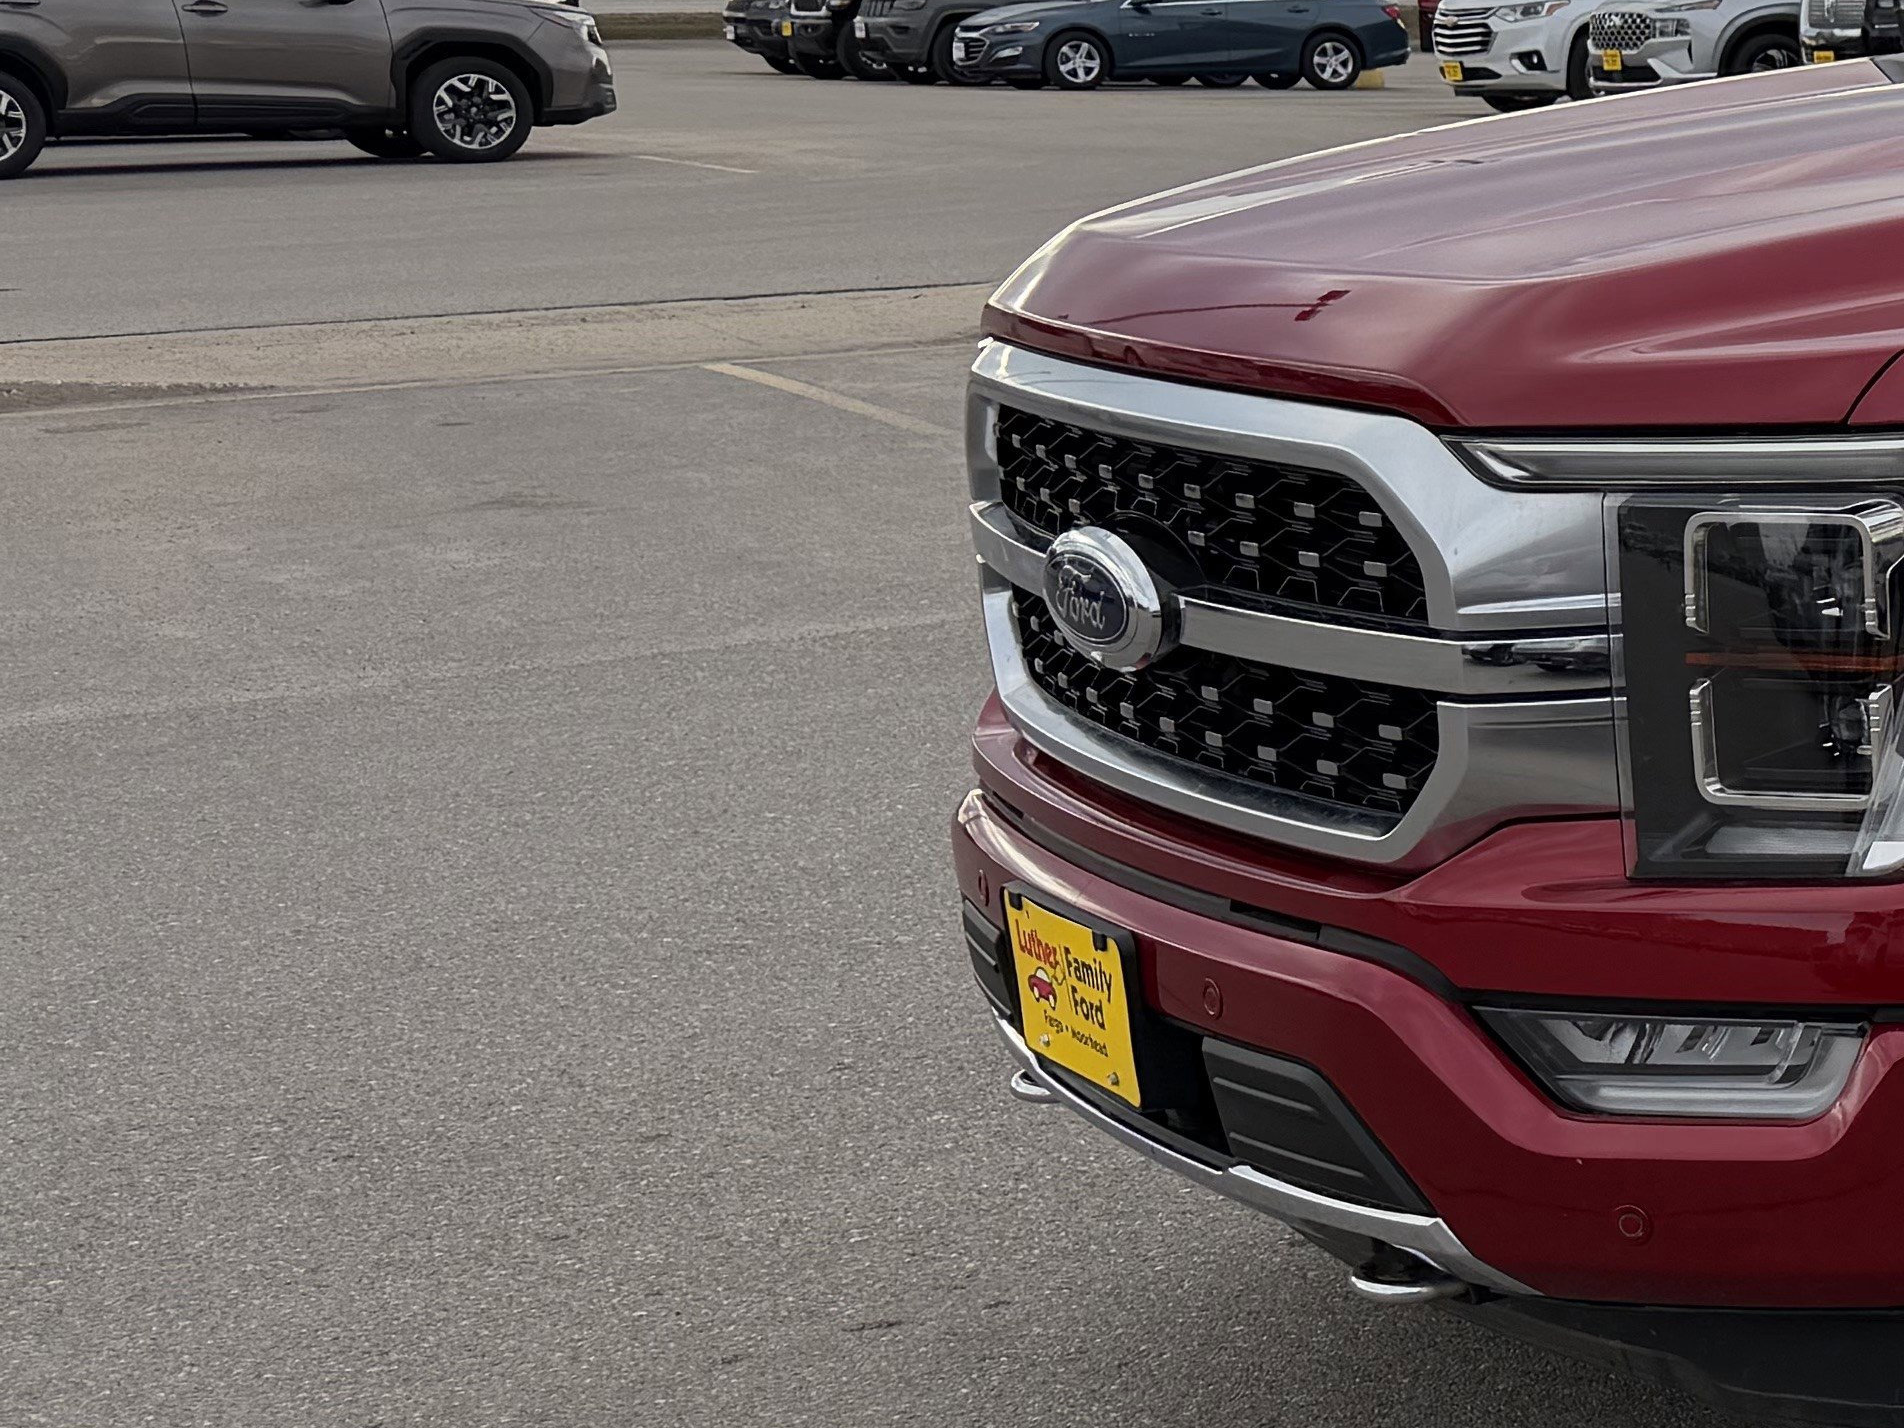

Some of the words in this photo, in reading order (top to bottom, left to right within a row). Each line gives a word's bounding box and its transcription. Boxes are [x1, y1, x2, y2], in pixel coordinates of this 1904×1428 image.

[1056, 564, 1106, 630] Ford
[1015, 918, 1059, 970] Luther
[1064, 946, 1112, 1004] Family
[1070, 984, 1106, 1031] Ford
